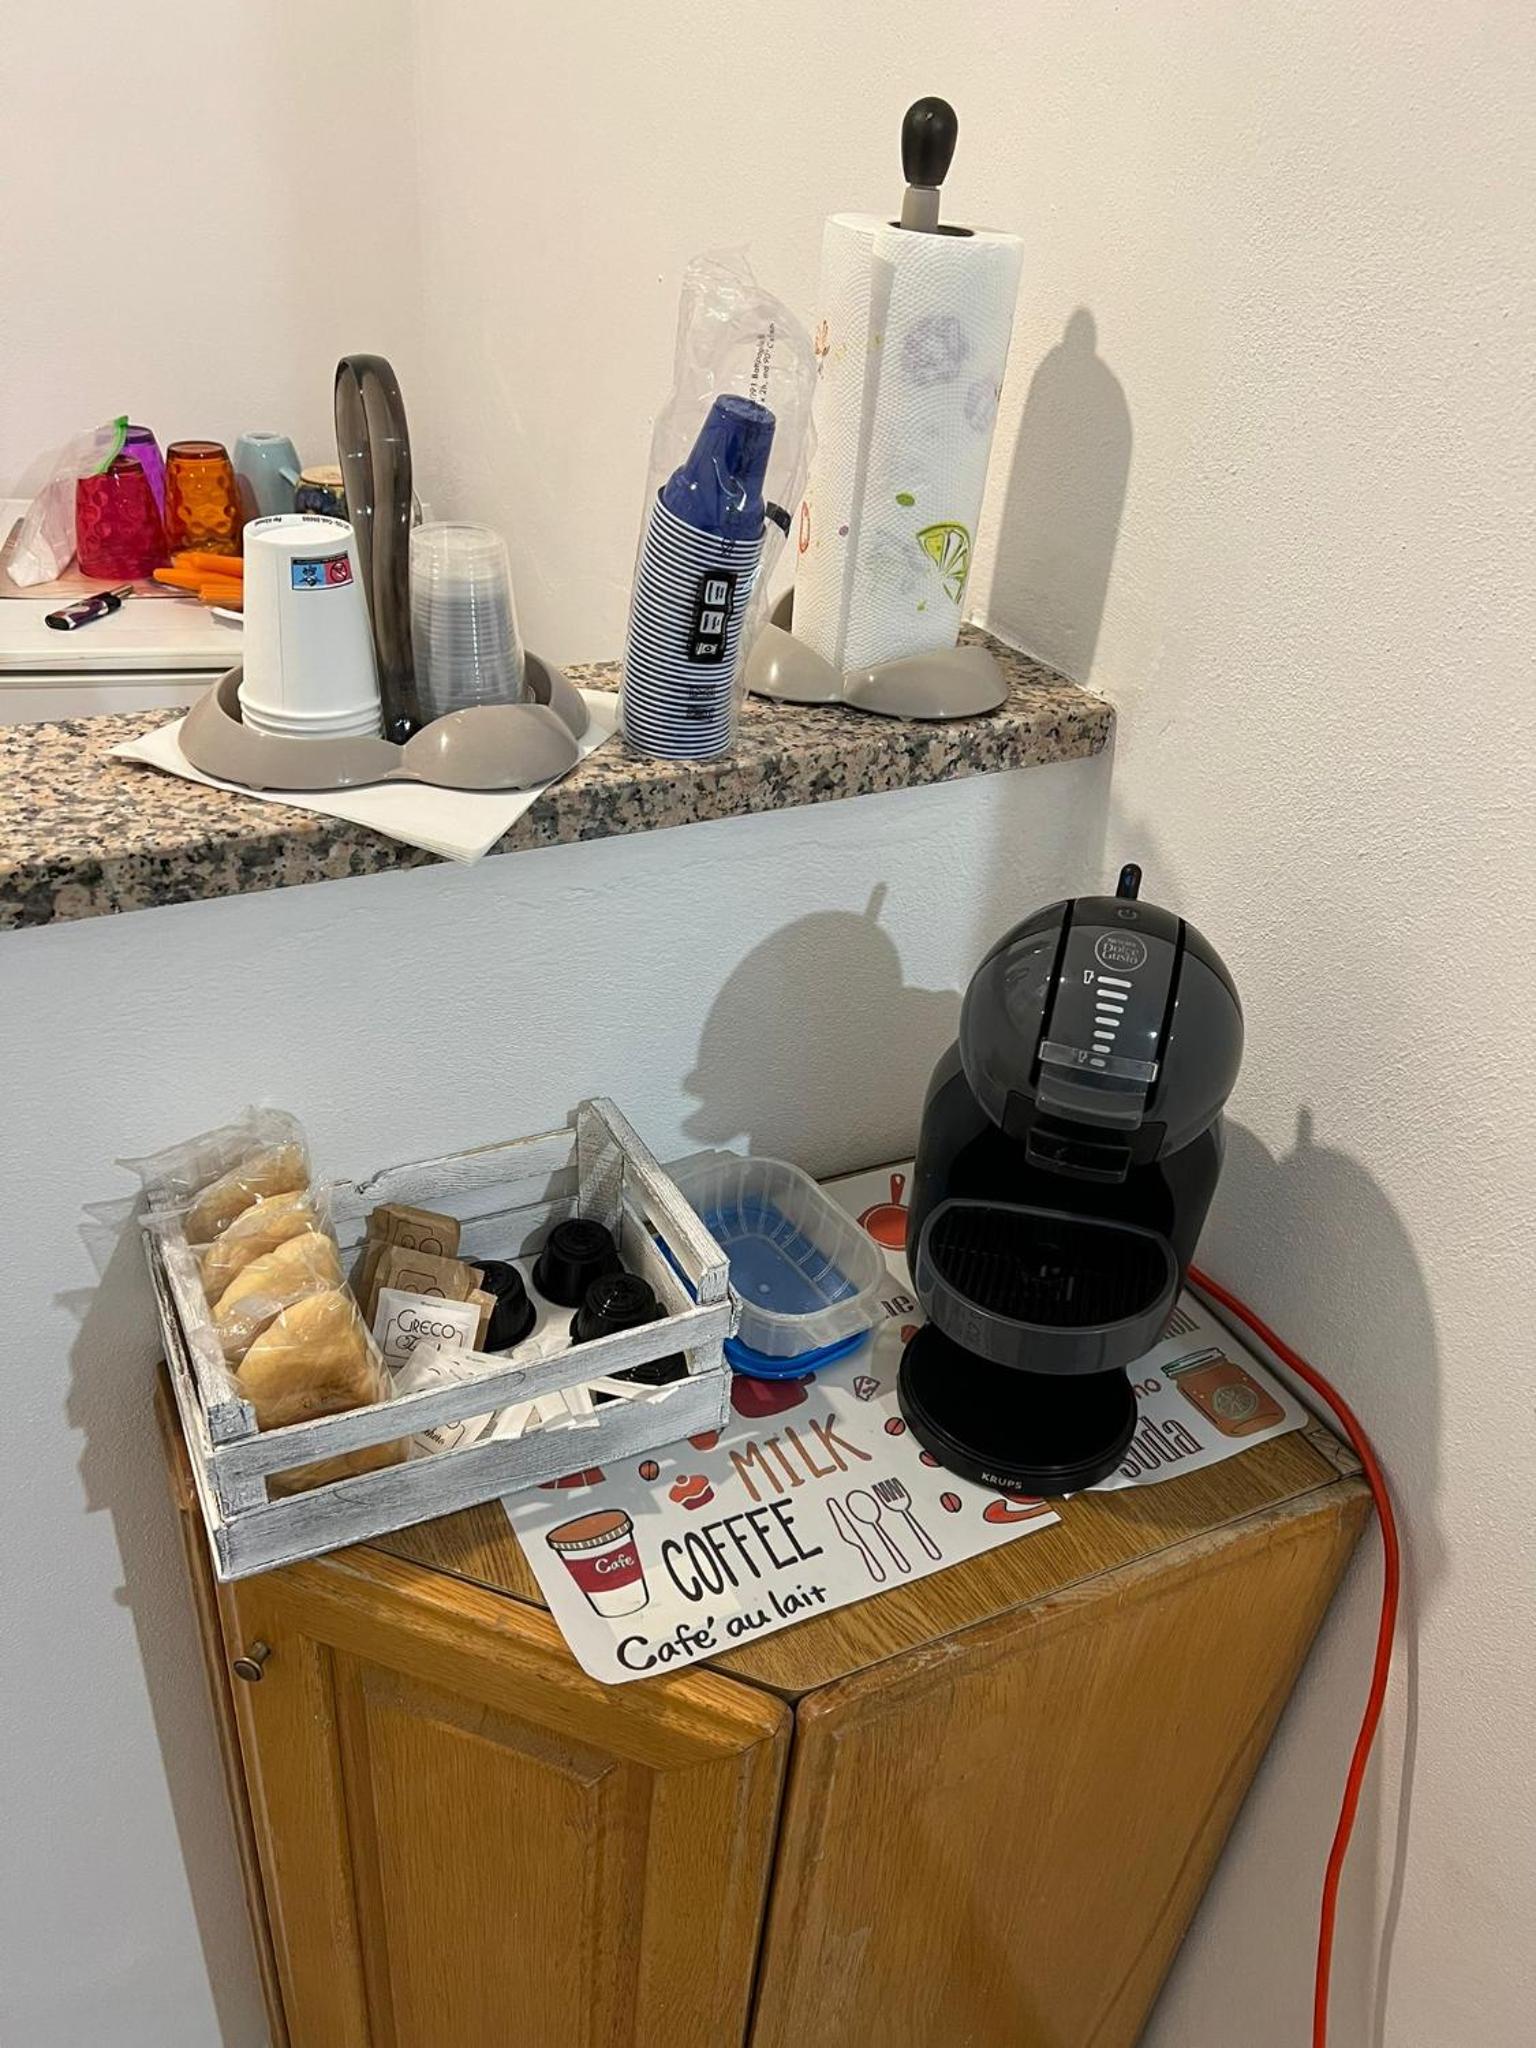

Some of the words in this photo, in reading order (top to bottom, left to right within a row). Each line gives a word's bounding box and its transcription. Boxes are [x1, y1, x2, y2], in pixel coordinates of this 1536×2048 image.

[729, 1413, 873, 1502] MILK
[980, 1471, 1023, 1492] KRUPS
[661, 1498, 823, 1602] COFFEE
[727, 1607, 772, 1638] au
[769, 1584, 828, 1619] lait
